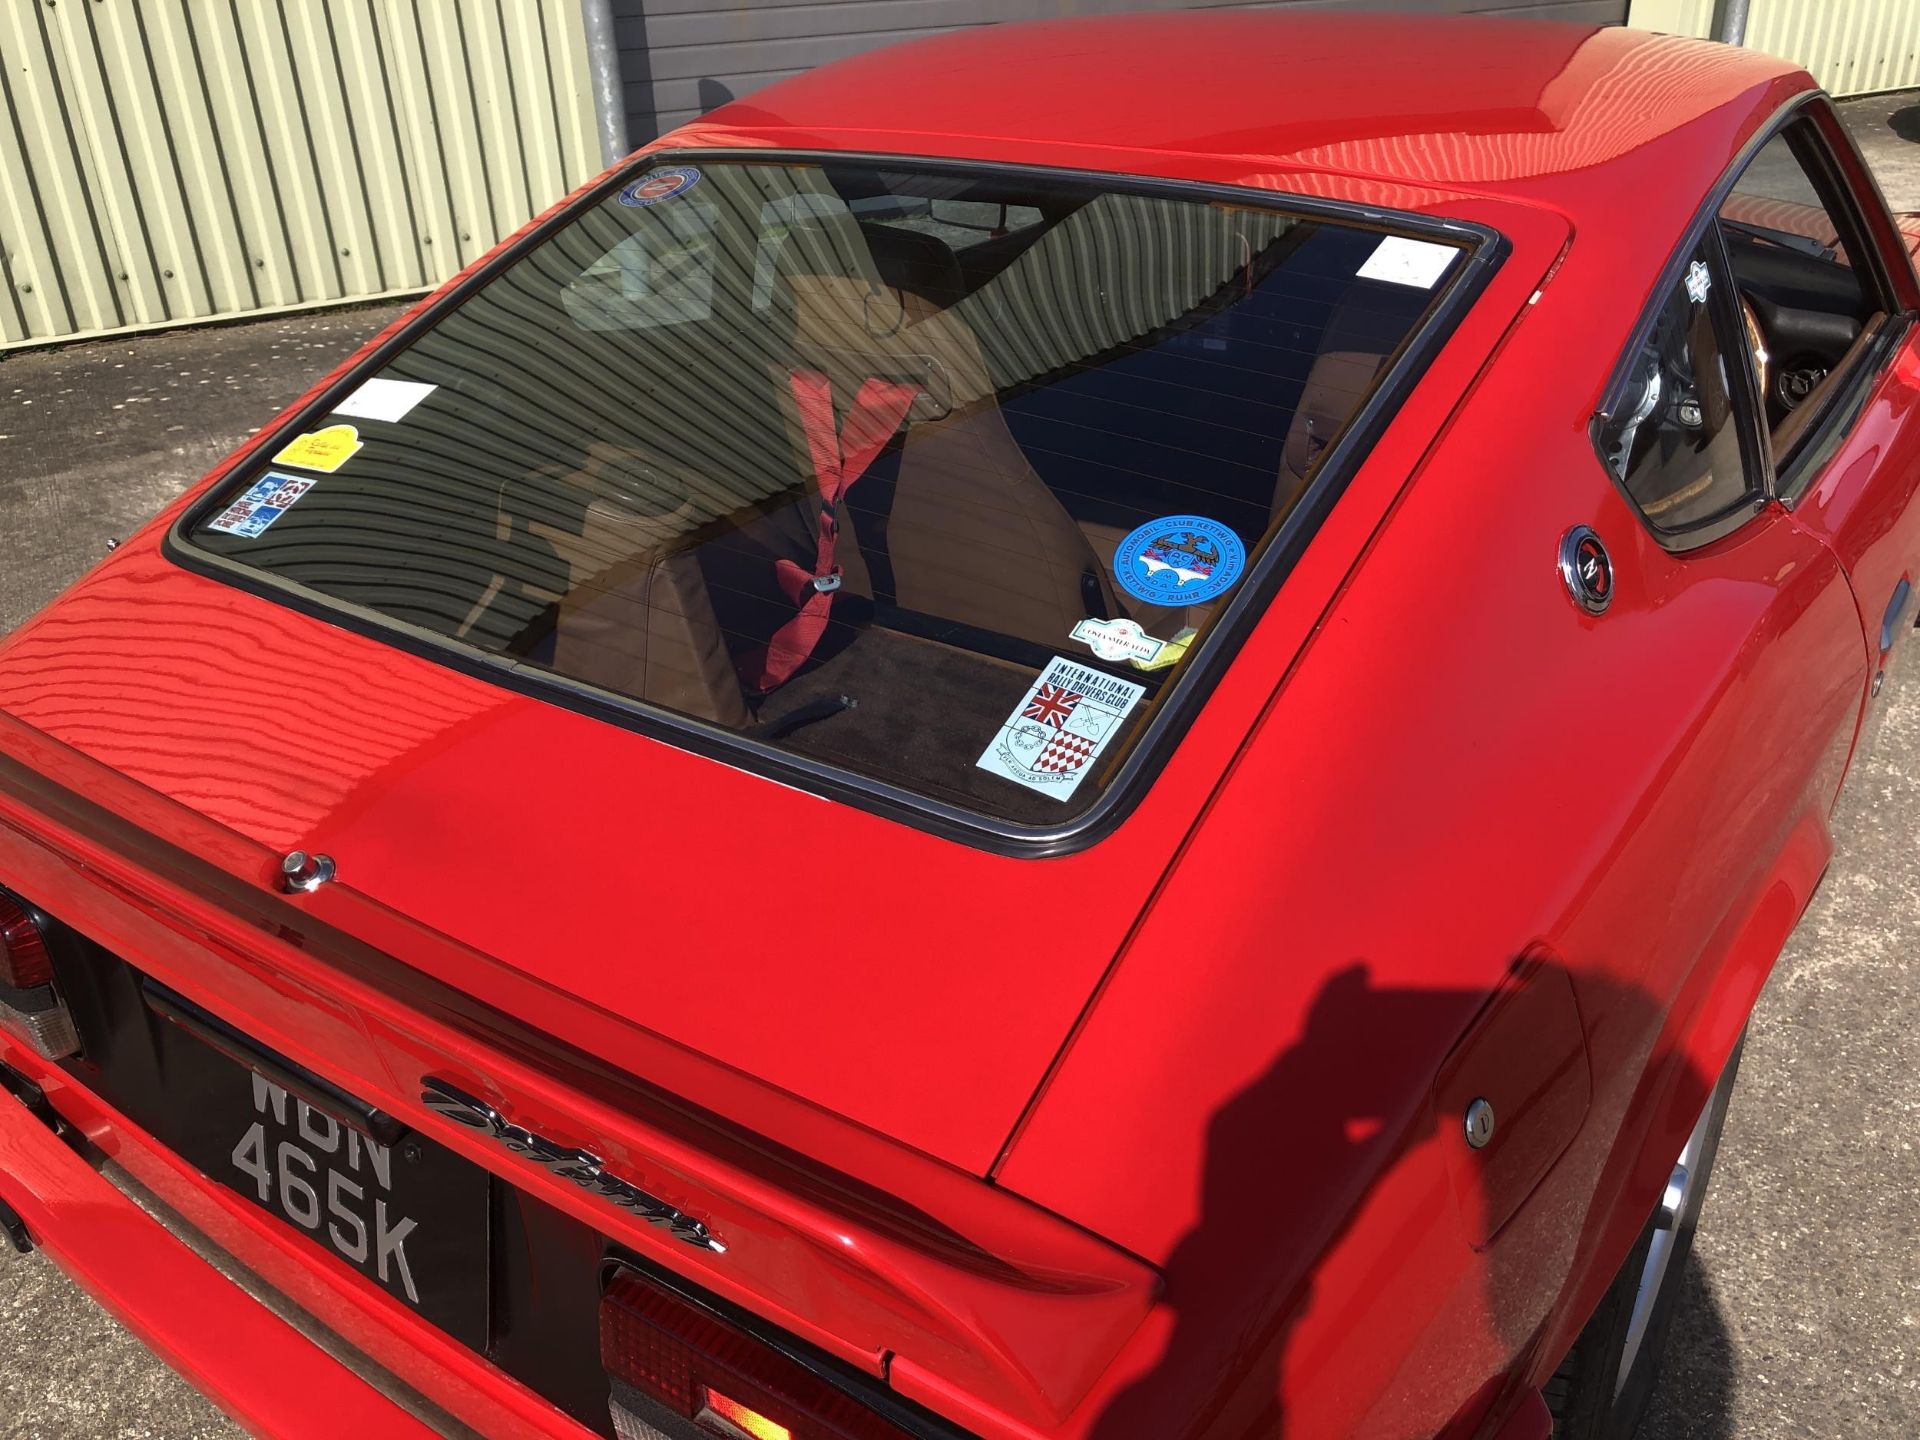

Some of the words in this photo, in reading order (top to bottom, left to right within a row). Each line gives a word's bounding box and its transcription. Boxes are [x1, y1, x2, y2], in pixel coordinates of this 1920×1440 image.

[1197, 521, 1233, 546] KETTWIG
[1122, 571, 1156, 598] KETTWIG
[1167, 591, 1200, 601] RUHR
[1046, 672, 1074, 690] RALLY
[1071, 680, 1107, 702] DRIVERS
[1105, 693, 1129, 709] CLUB
[1053, 662, 1135, 699] INTERNATIONAL
[420, 1074, 729, 1254] Datsun
[231, 1121, 420, 1304] 465K
